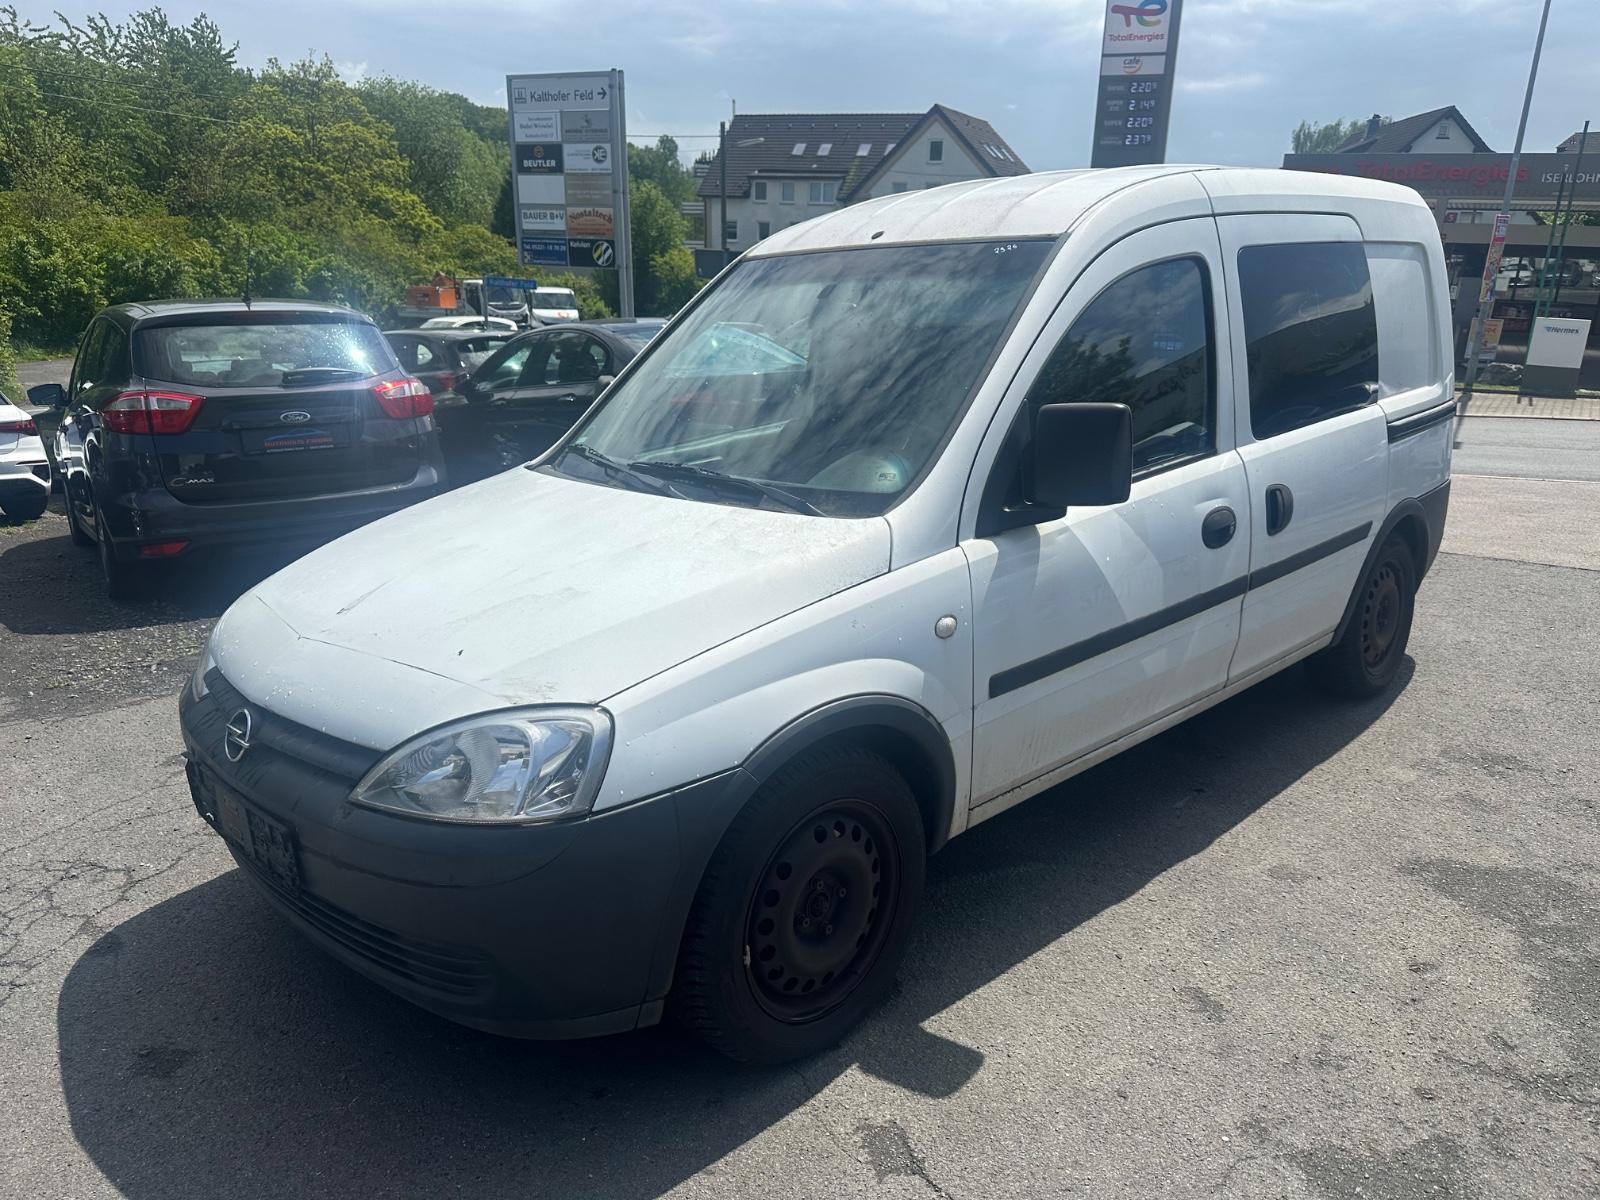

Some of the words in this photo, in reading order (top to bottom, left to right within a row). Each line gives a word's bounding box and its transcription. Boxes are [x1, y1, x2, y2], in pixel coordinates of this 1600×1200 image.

[1108, 32, 1165, 42] TotalEnergies
[530, 90, 570, 103] Kalthofer
[574, 89, 593, 101] Feld
[523, 159, 556, 168] BEUTLER
[522, 211, 548, 221] BAUER
[1551, 326, 1579, 334] Hermes
